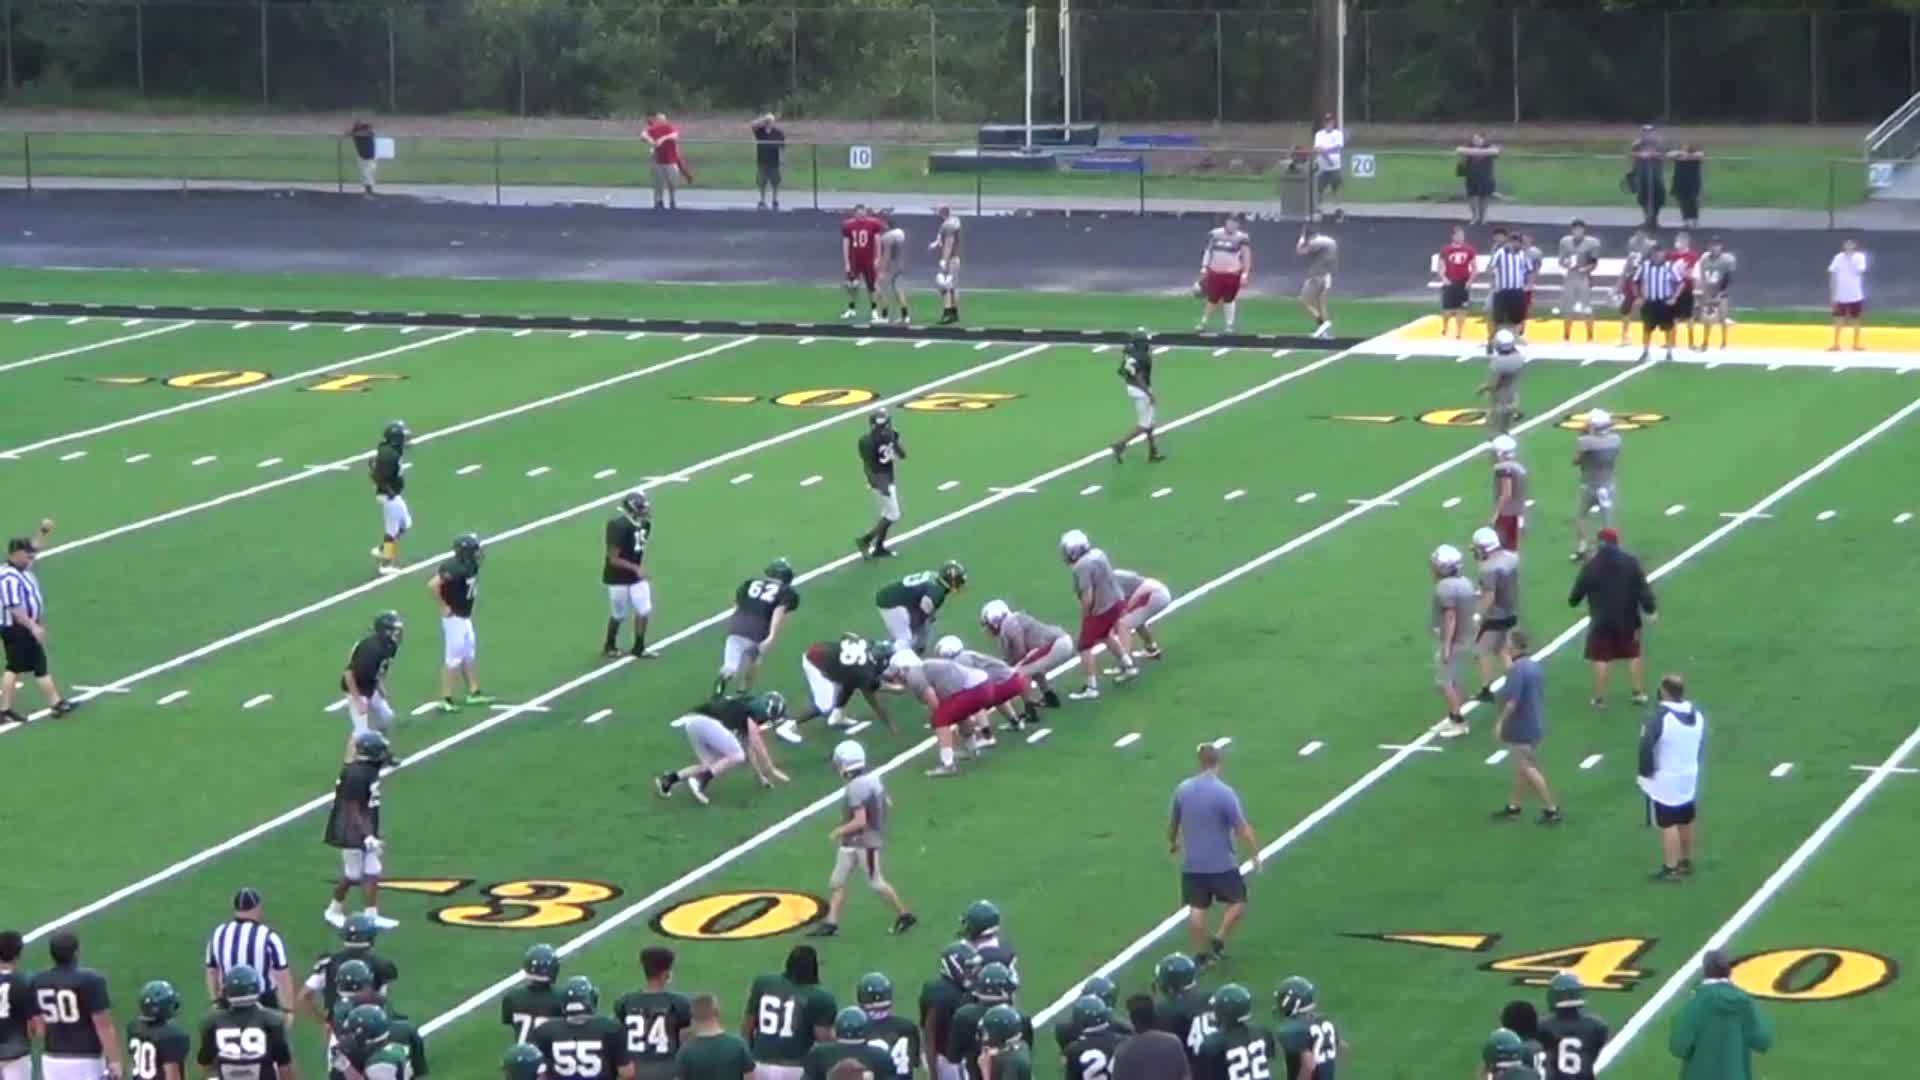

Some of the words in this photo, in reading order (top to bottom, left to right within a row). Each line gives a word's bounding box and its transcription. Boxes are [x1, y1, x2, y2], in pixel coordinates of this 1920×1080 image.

[852, 149, 870, 165] 10
[1353, 157, 1373, 174] 20
[851, 229, 868, 248] 10
[747, 581, 780, 602] 62
[427, 878, 830, 941] 30
[1476, 936, 1900, 1002] 40
[36, 987, 81, 1023] 50
[759, 995, 796, 1037] 61
[215, 1028, 267, 1060] 59
[624, 1015, 669, 1053] 24
[1309, 1021, 1336, 1063] 23
[128, 1038, 156, 1079] 30
[551, 1040, 603, 1078] 55
[1225, 1039, 1270, 1080] 22
[1558, 1037, 1582, 1074] 6
